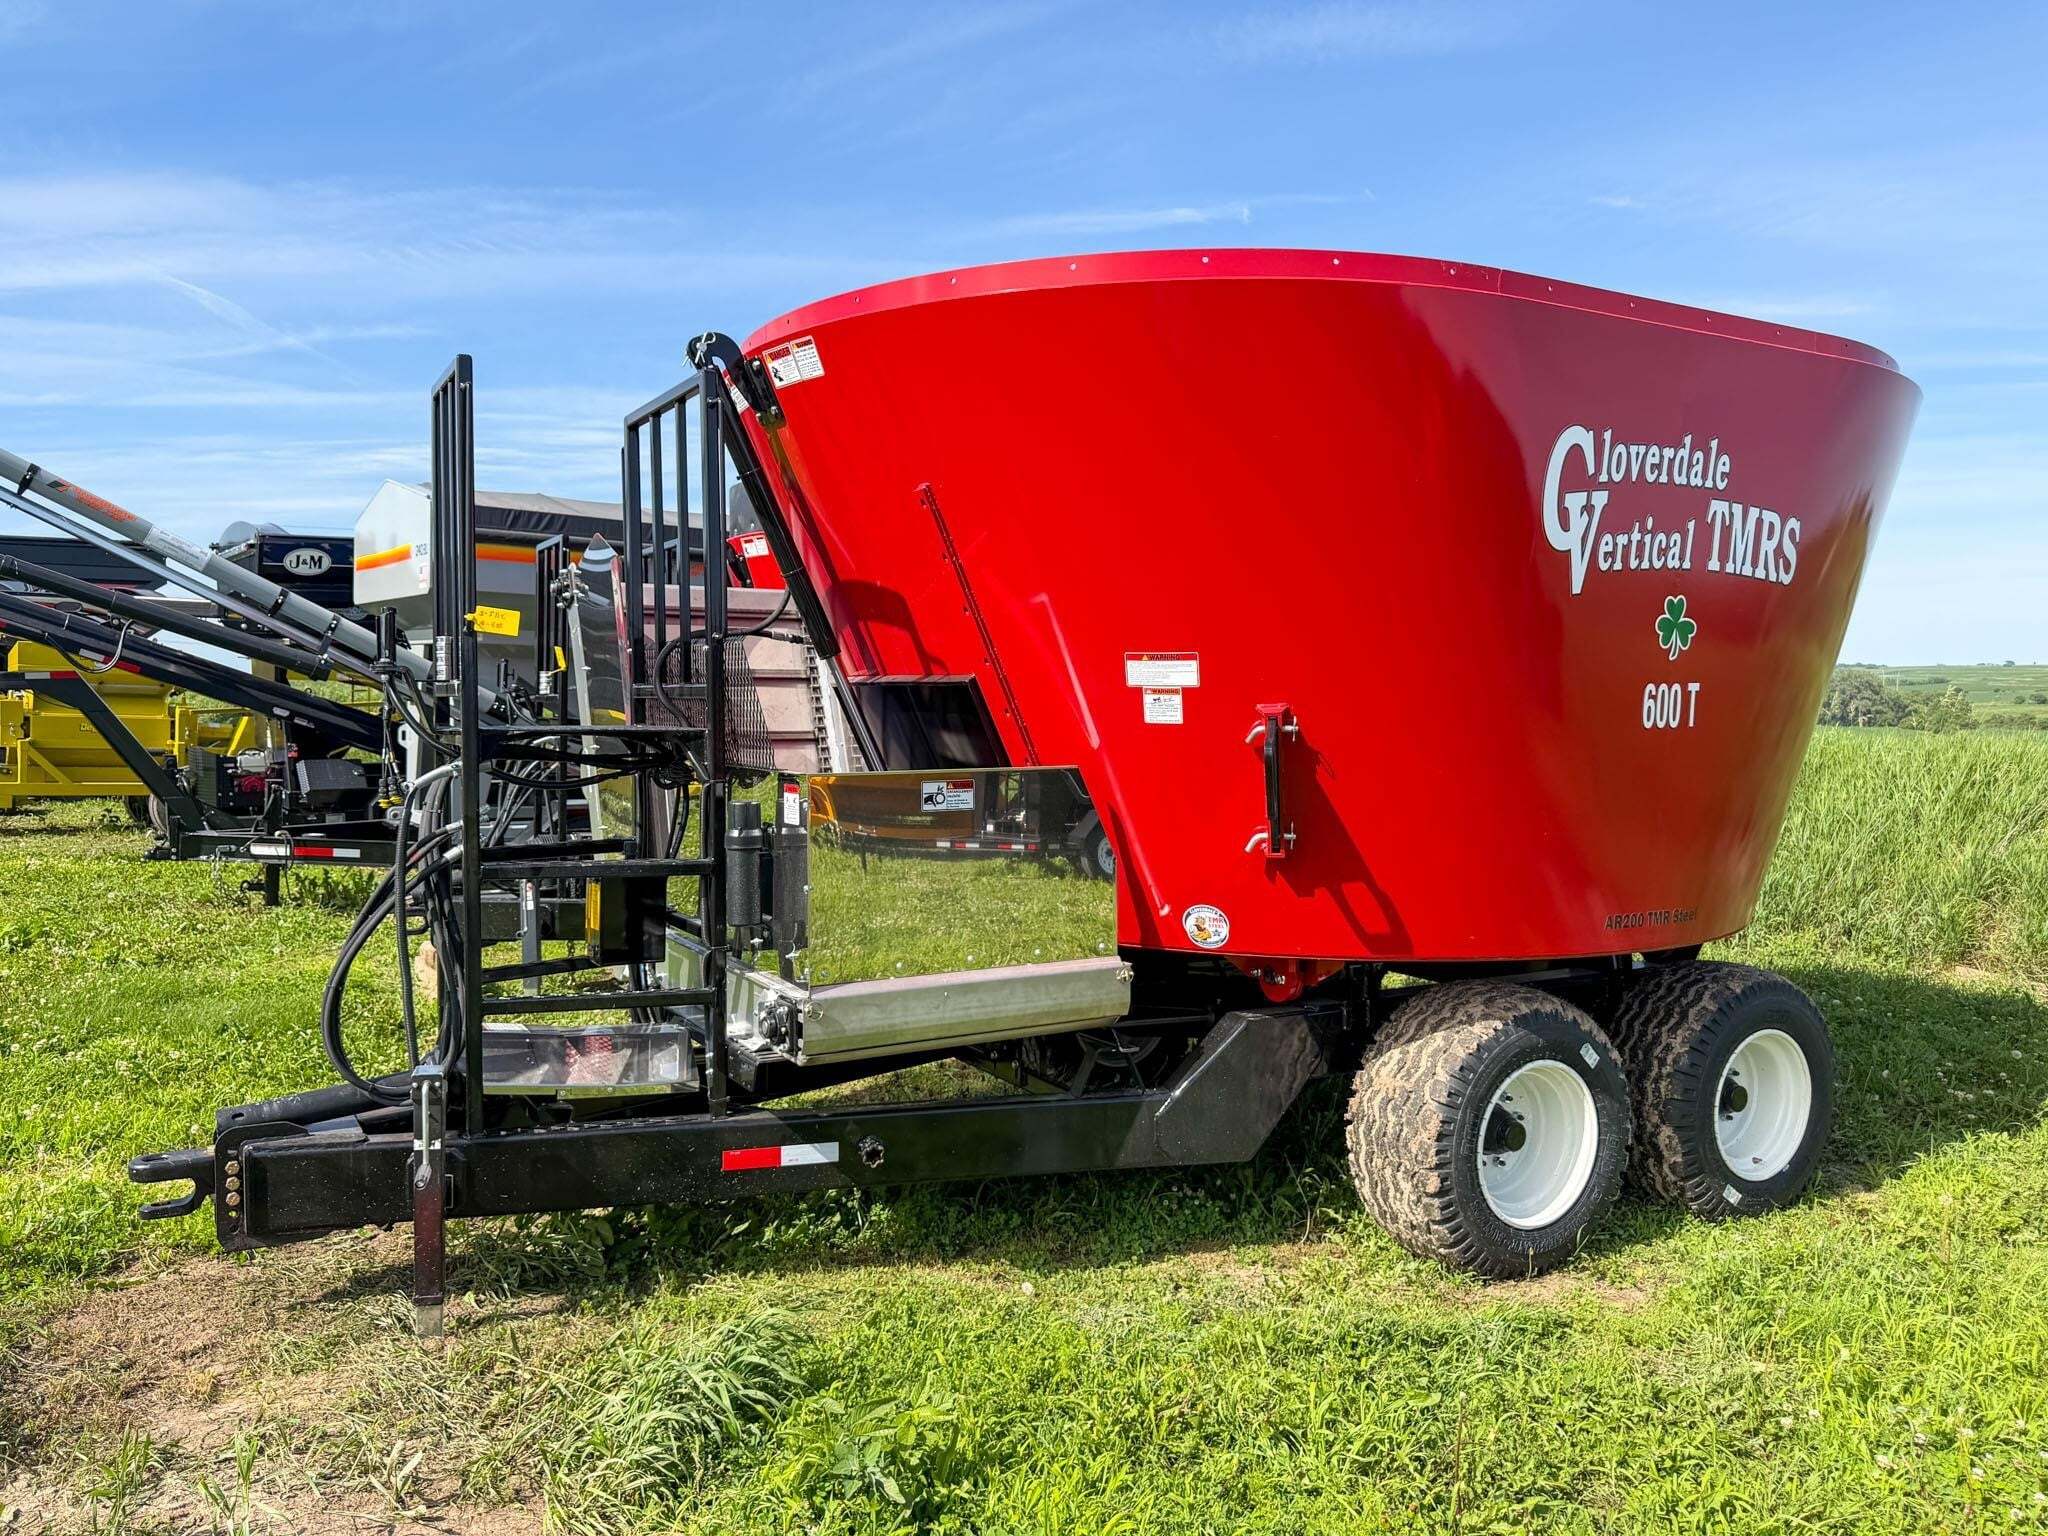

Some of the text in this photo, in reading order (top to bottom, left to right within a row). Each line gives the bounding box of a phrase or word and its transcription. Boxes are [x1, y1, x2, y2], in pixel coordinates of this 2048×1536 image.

[1543, 424, 1732, 552] Cloverdale
[289, 555, 323, 570] J&M
[1563, 490, 1801, 596] Vertical TMRS
[1642, 682, 1701, 729] 600 T
[1604, 912, 1645, 930] AR200
[1646, 910, 1671, 926] TMR
